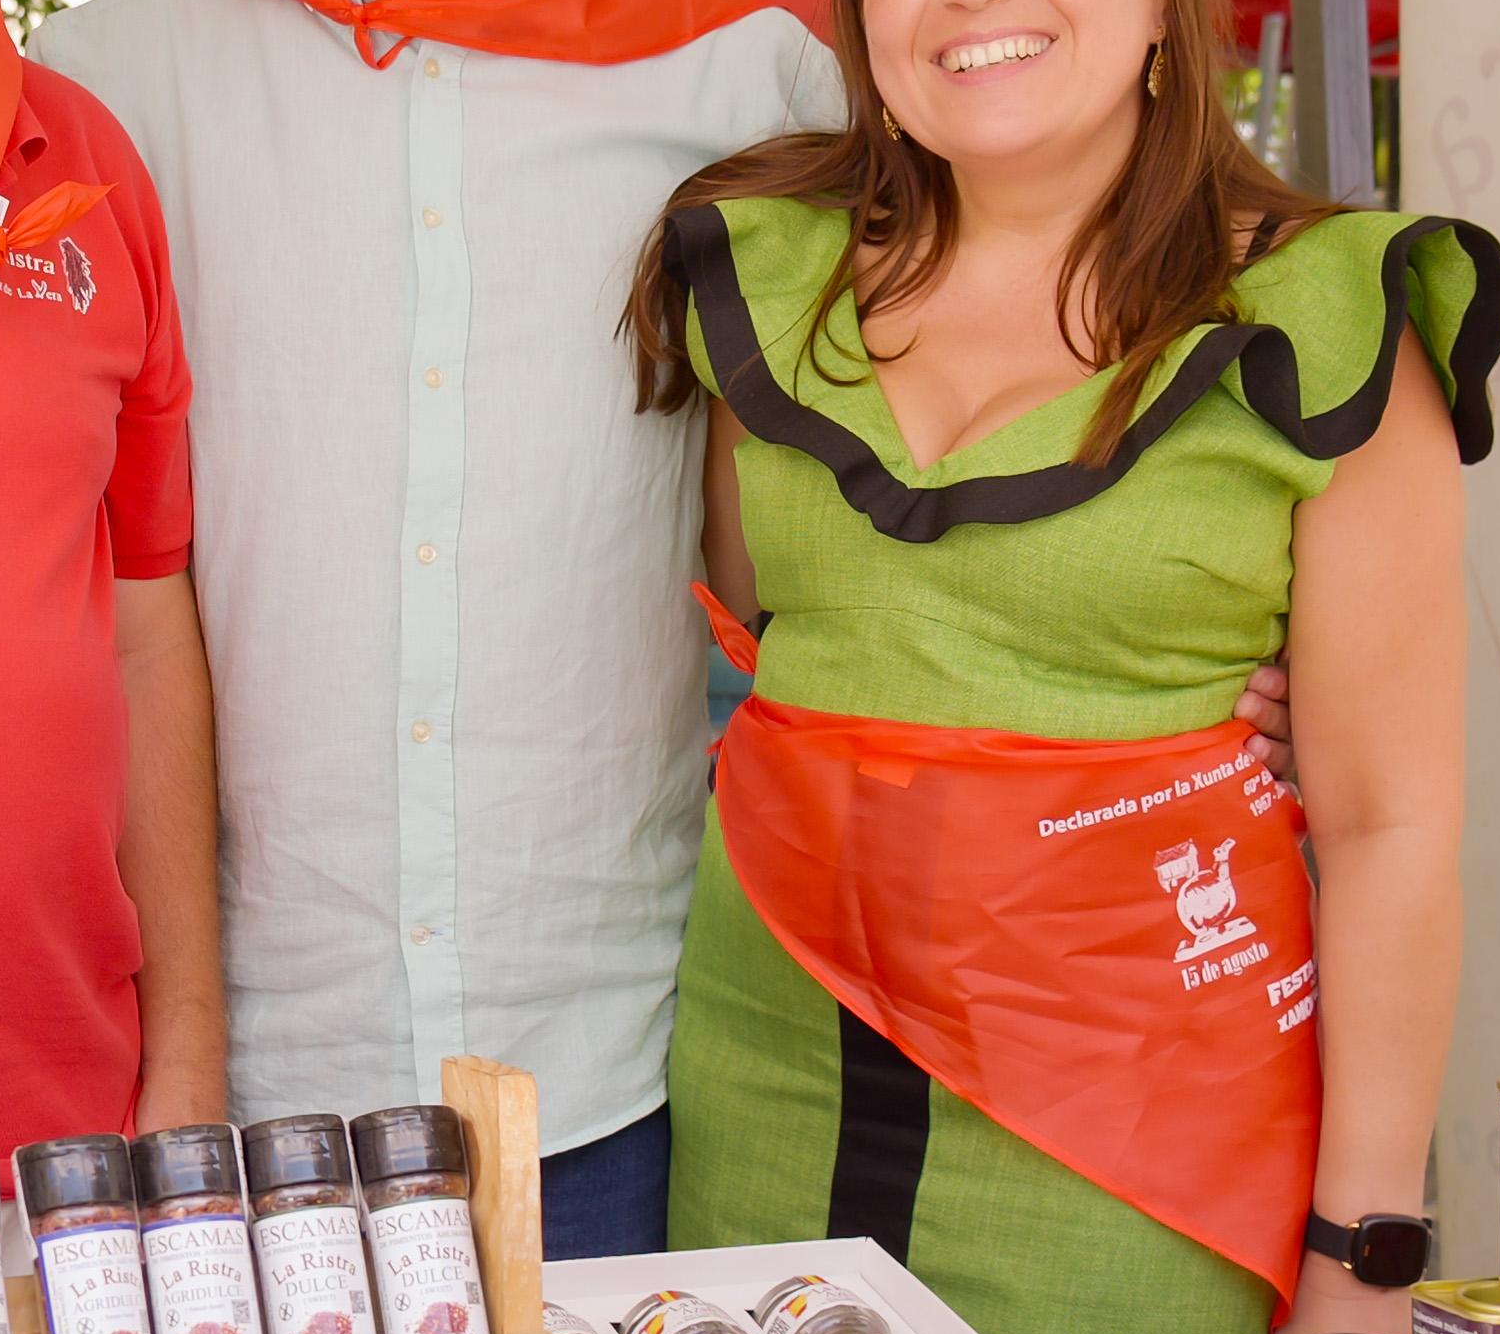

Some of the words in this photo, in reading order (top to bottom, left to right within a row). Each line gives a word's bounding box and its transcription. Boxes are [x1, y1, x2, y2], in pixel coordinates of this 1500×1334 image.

[6, 247, 55, 275] istra
[1039, 797, 1137, 838] Declarada
[1141, 786, 1172, 814] por
[1175, 780, 1191, 797] la
[1193, 760, 1234, 790] Xunta
[1233, 751, 1251, 771] de
[1181, 967, 1200, 991] 15
[1202, 960, 1219, 983] de
[1221, 941, 1269, 976] agosto
[260, 1217, 357, 1247] ESCAMAS
[375, 1209, 470, 1239] ESCAMAS
[149, 1228, 244, 1256] ESCAMAS
[161, 1265, 183, 1290] La
[189, 1259, 241, 1282] Ristra
[272, 1265, 295, 1284] La
[302, 1251, 356, 1276] Ristra
[388, 1255, 411, 1276] La
[419, 1244, 471, 1266] Ristra
[286, 1275, 348, 1297] DULCE
[402, 1266, 464, 1287] DULCE
[163, 1285, 244, 1306] AGRIDULCE
